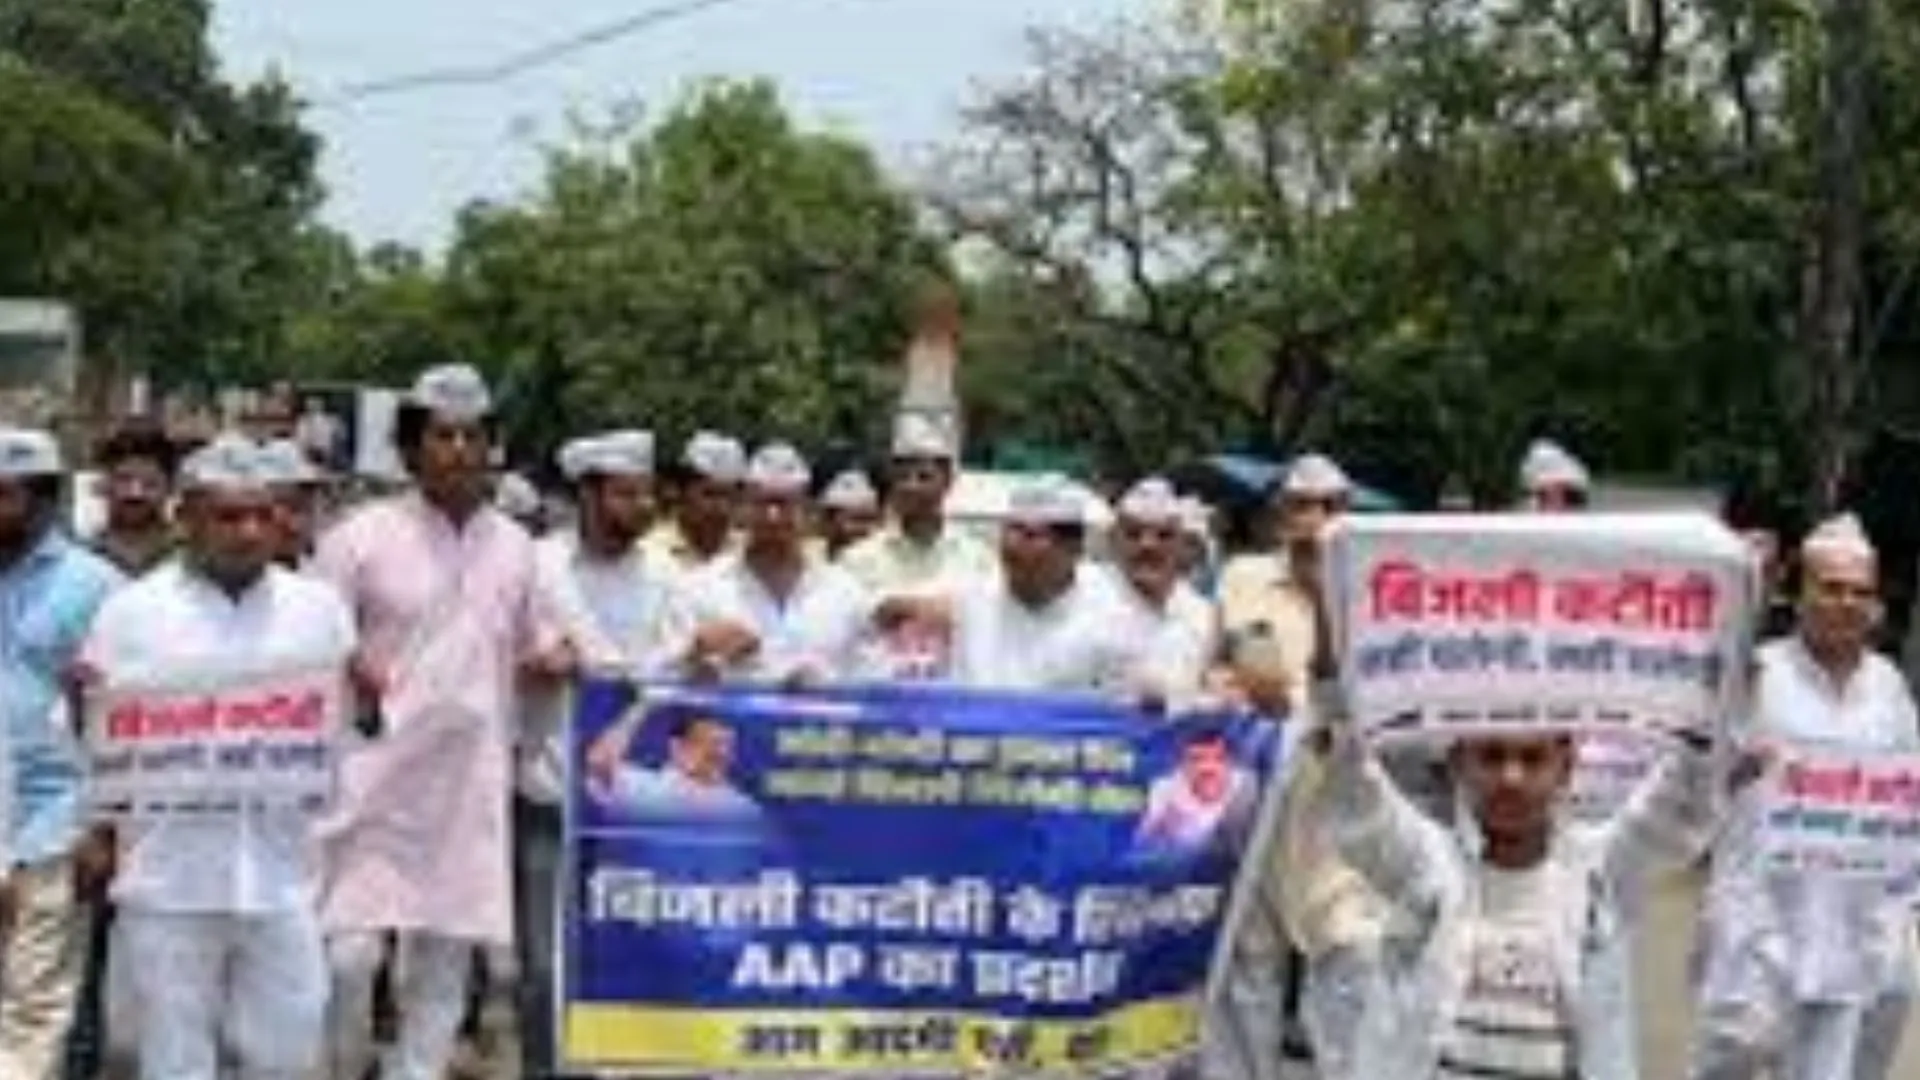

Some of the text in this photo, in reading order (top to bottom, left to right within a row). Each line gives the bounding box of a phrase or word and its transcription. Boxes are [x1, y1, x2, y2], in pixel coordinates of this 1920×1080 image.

[1371, 561, 1716, 630] बिजली कटौती
[589, 868, 799, 930] बिजली
[814, 874, 993, 937] कटौती
[732, 943, 863, 988] AAP
[882, 946, 959, 990] का
